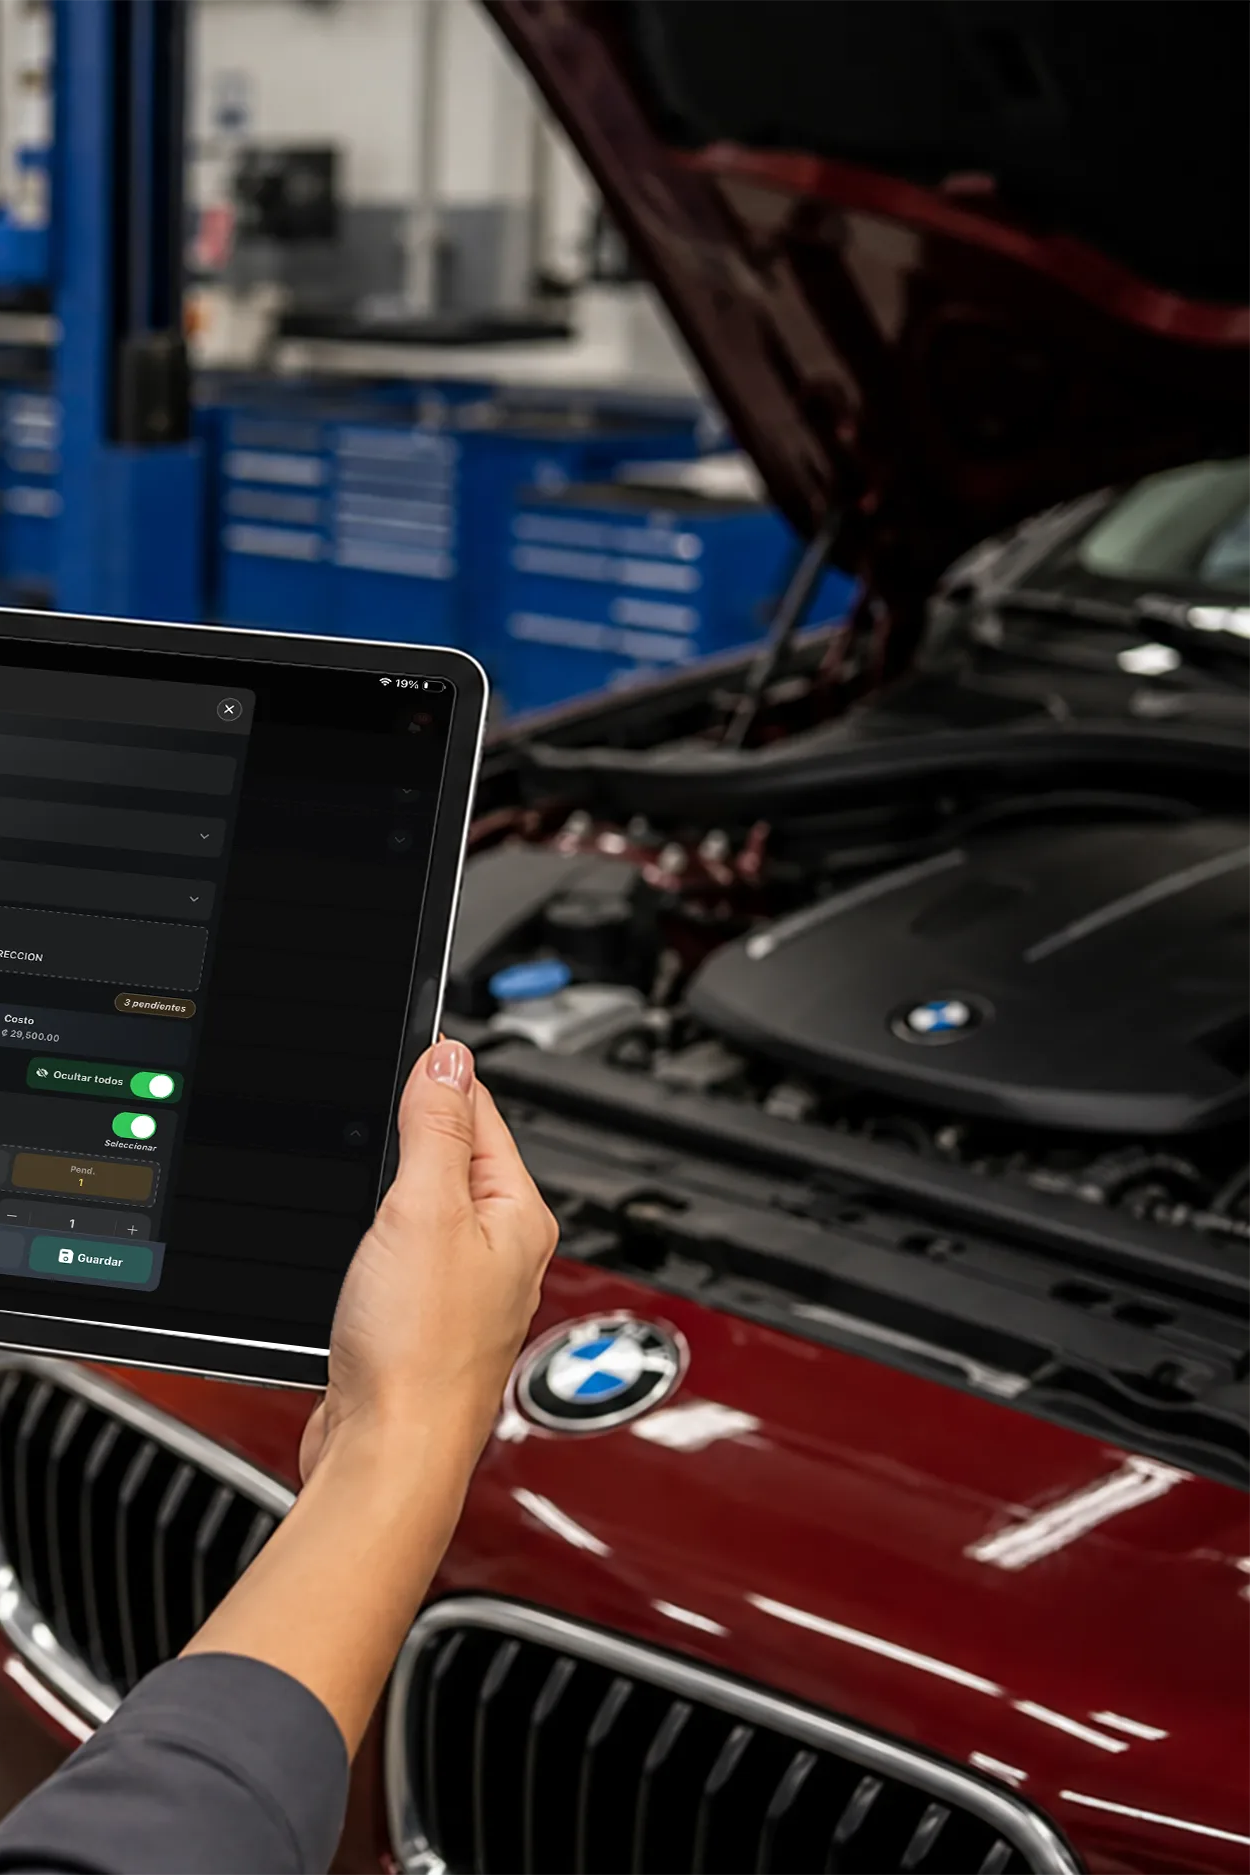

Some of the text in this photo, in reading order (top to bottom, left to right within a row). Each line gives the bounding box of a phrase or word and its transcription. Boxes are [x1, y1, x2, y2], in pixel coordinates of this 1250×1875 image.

[395, 678, 419, 689] 19%
[123, 998, 187, 1013] 3 pendientes
[4, 1014, 35, 1025] Costo
[10, 1029, 60, 1042] 29,500.00
[53, 1070, 124, 1086] Ocultar todos
[104, 1139, 157, 1152] Seleccionar
[70, 1165, 96, 1176] Pend.
[78, 1178, 84, 1187] 1
[69, 1218, 75, 1229] 1
[77, 1253, 123, 1267] Guardar
